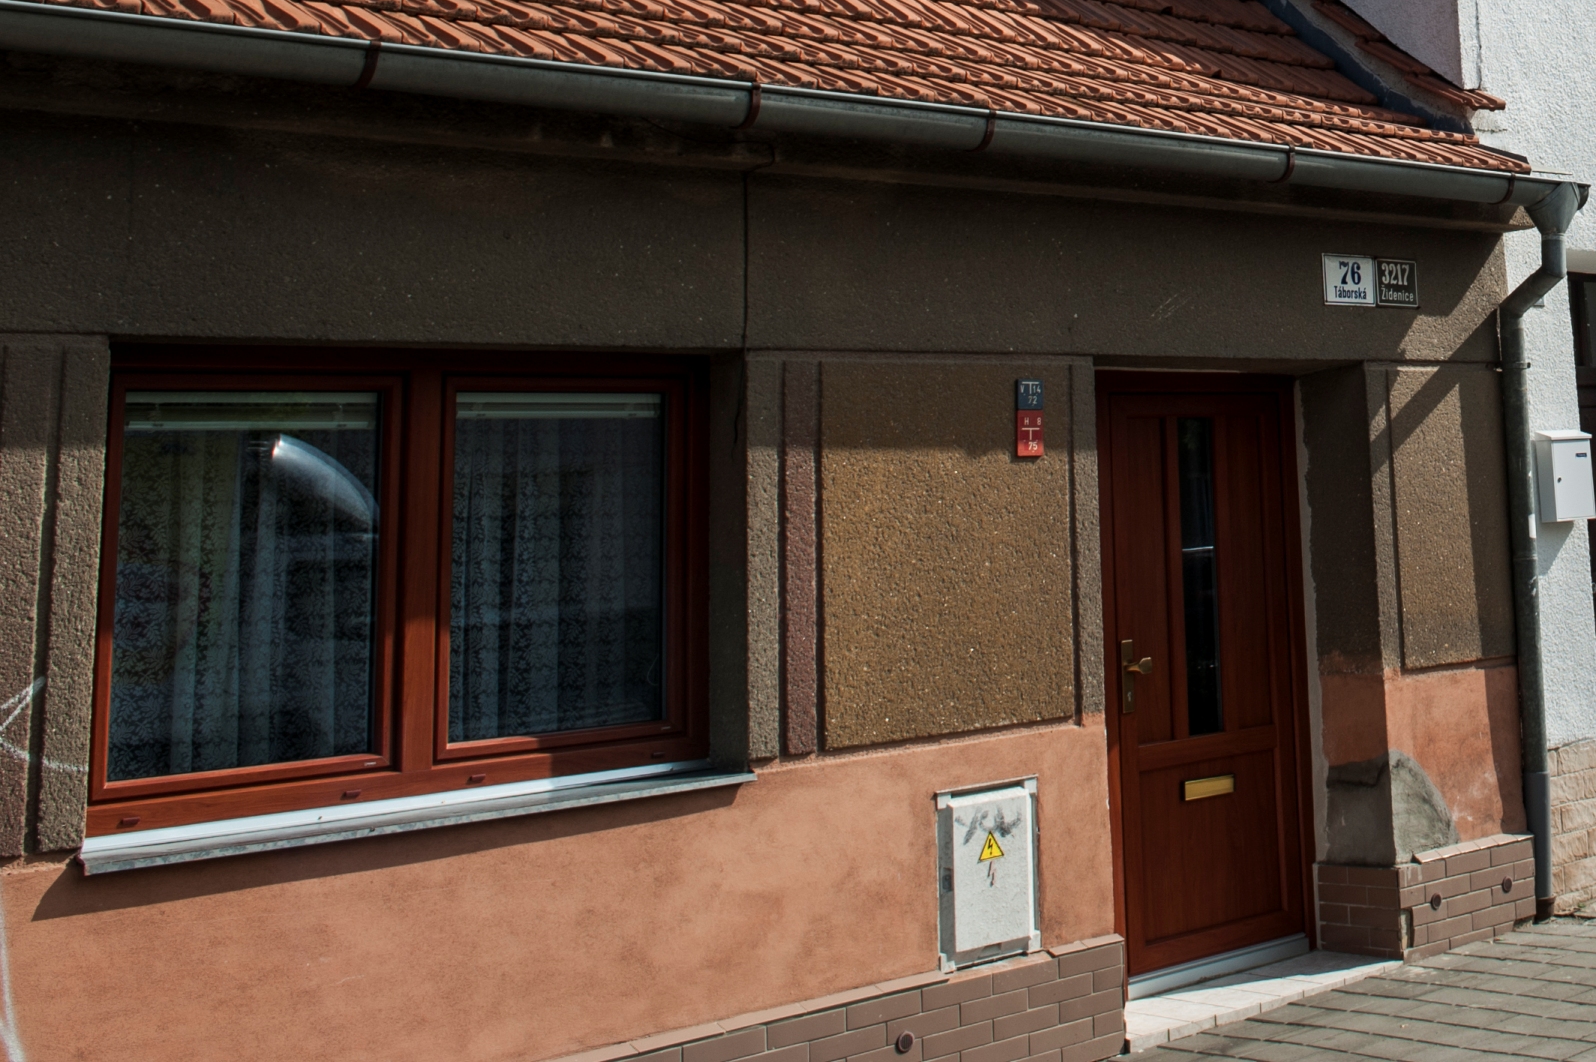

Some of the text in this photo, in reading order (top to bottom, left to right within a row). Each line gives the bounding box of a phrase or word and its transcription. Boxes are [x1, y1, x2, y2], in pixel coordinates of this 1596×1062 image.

[1339, 261, 1361, 285] 76
[1381, 263, 1409, 285] 3217
[1334, 286, 1367, 300] Táborská
[1381, 285, 1414, 301] Židenice
